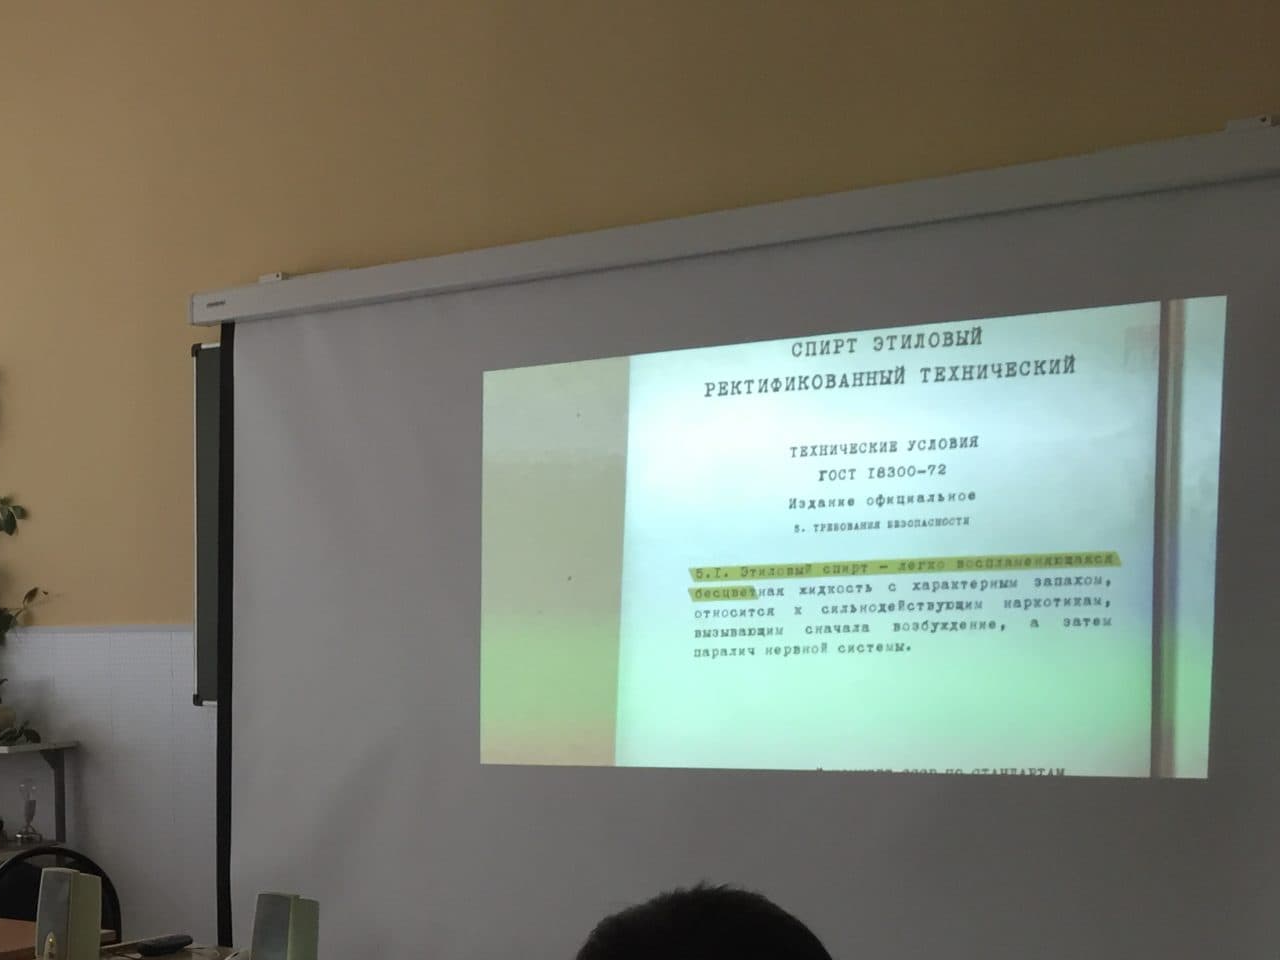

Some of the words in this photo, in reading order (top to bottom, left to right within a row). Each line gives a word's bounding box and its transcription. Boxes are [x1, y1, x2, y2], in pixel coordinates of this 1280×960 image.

[791, 338, 858, 358] СПИРТ
[873, 326, 983, 352] ЭТИЛОВЫЙ
[704, 366, 906, 397] РЕКТИФИКОВАННЫЙ
[920, 355, 1076, 384] ТЕХНИЧЕСКИЙ
[790, 441, 898, 458] ТЕХНИЧЕСКИЕ
[907, 435, 979, 451] УСЛОВИЯ
[818, 468, 857, 482] ГОСТ
[789, 497, 856, 510] Издание
[866, 491, 977, 508] официальное
[813, 520, 881, 533] ТРЕБОВАНИЯ
[887, 516, 970, 529] БЕЗОПАСНОСТИ
[823, 564, 868, 576] спирт
[799, 583, 873, 597] жидкость
[912, 577, 1018, 593] характерным
[694, 606, 775, 619] относится
[694, 626, 784, 639] вызывающим
[805, 622, 870, 635] сначала
[1063, 616, 1113, 628] затем
[694, 647, 756, 659] паралич
[765, 642, 828, 658] нервной
